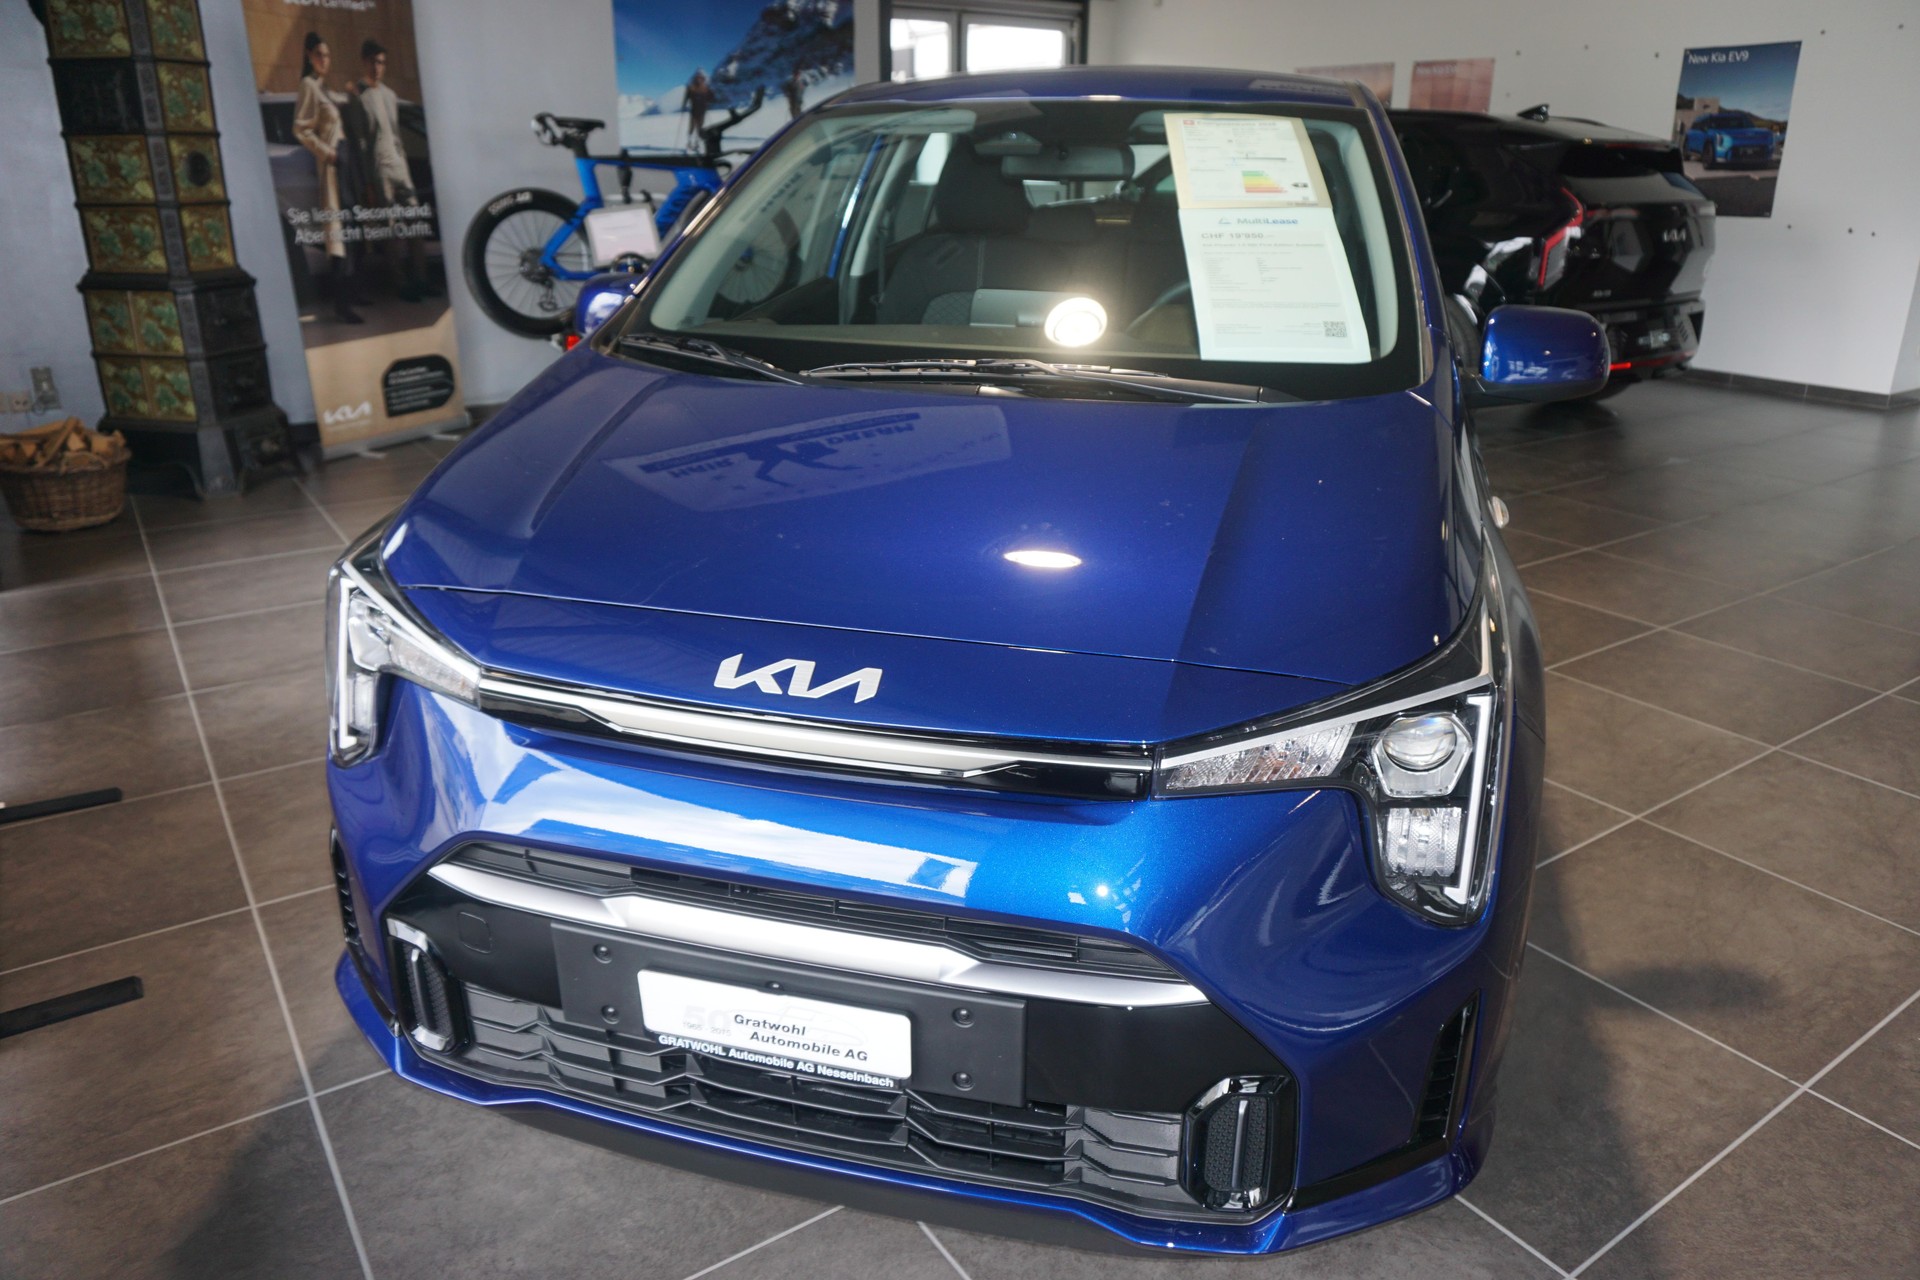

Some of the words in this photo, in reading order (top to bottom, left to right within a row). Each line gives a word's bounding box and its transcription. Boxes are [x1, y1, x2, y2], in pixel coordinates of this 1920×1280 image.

[1688, 54, 1709, 64] New
[1711, 52, 1726, 63] Kia
[1728, 50, 1749, 62] EV9
[287, 207, 309, 225] Sie
[1237, 217, 1298, 225] MultiLease
[294, 229, 325, 244] Aber
[363, 225, 393, 240] beim
[713, 653, 883, 704] KIA
[734, 1014, 805, 1036] Gratwohl
[750, 1031, 841, 1057] Automobile
[844, 1048, 868, 1062] AG
[658, 1034, 726, 1056] GRATWOHL
[728, 1048, 794, 1069] Automobile
[796, 1061, 815, 1073] AG
[817, 1064, 895, 1088] Nesselnbach
